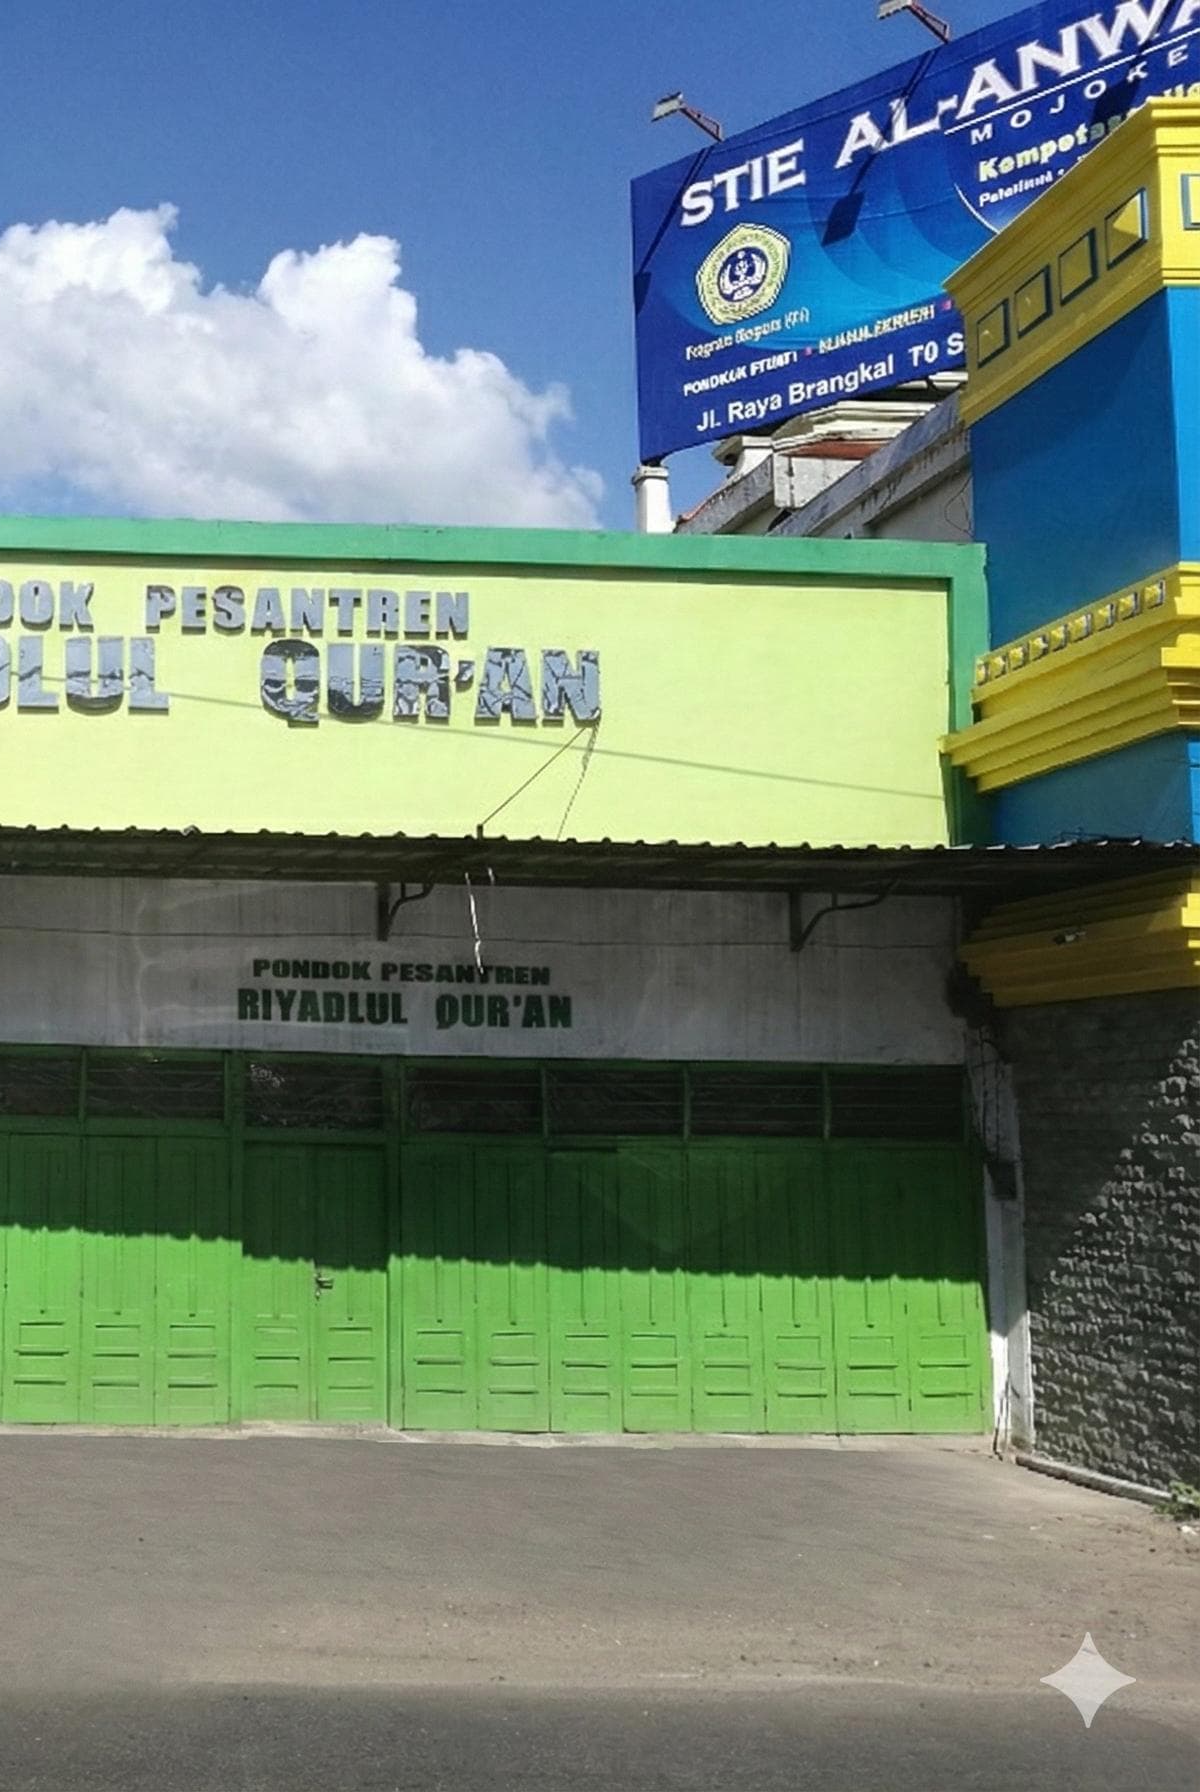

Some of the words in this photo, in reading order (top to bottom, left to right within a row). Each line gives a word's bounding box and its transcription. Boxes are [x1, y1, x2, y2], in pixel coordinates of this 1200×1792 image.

[680, 138, 806, 226] STIE
[728, 393, 782, 423] Raya
[788, 353, 894, 405] Brangkal
[145, 585, 469, 640] PESANTREN
[260, 638, 601, 728] QUR'AN
[253, 959, 371, 981] PONDOK
[381, 963, 550, 986] PESANTREN
[237, 988, 408, 1025] RIYADLUL
[435, 994, 572, 1030] QUR'AN
